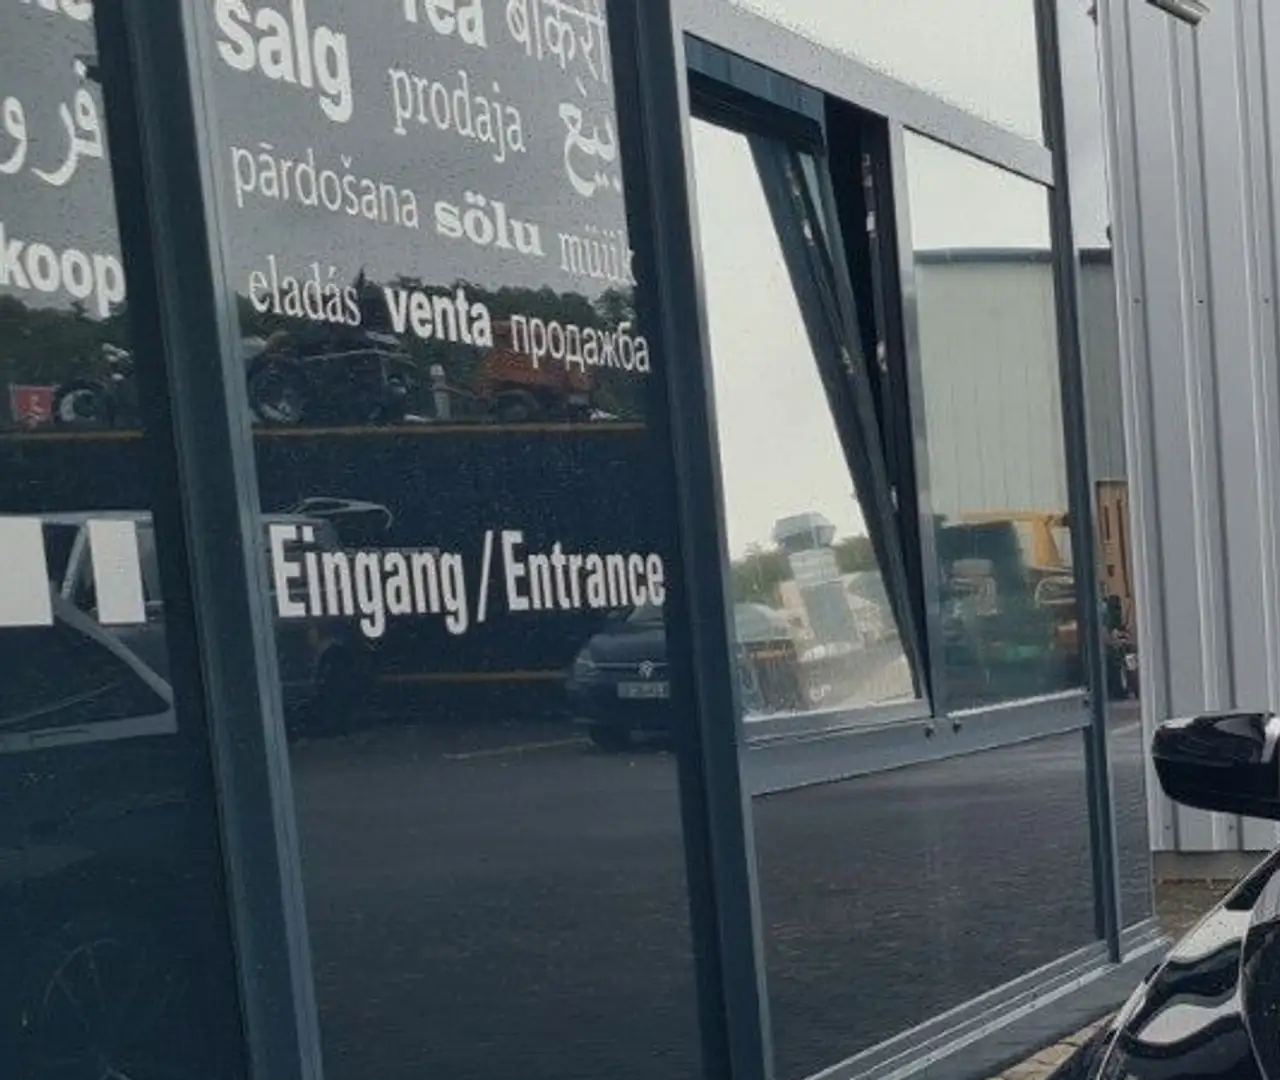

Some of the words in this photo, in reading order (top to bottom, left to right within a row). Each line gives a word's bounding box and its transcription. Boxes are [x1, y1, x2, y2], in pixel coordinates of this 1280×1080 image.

[215, 0, 352, 122] salg
[389, 68, 526, 163] prodaja
[232, 142, 419, 229] pārdošana
[434, 190, 545, 256] sölu
[249, 253, 362, 327] eladás
[382, 285, 494, 348] venta
[510, 313, 651, 373] продажба
